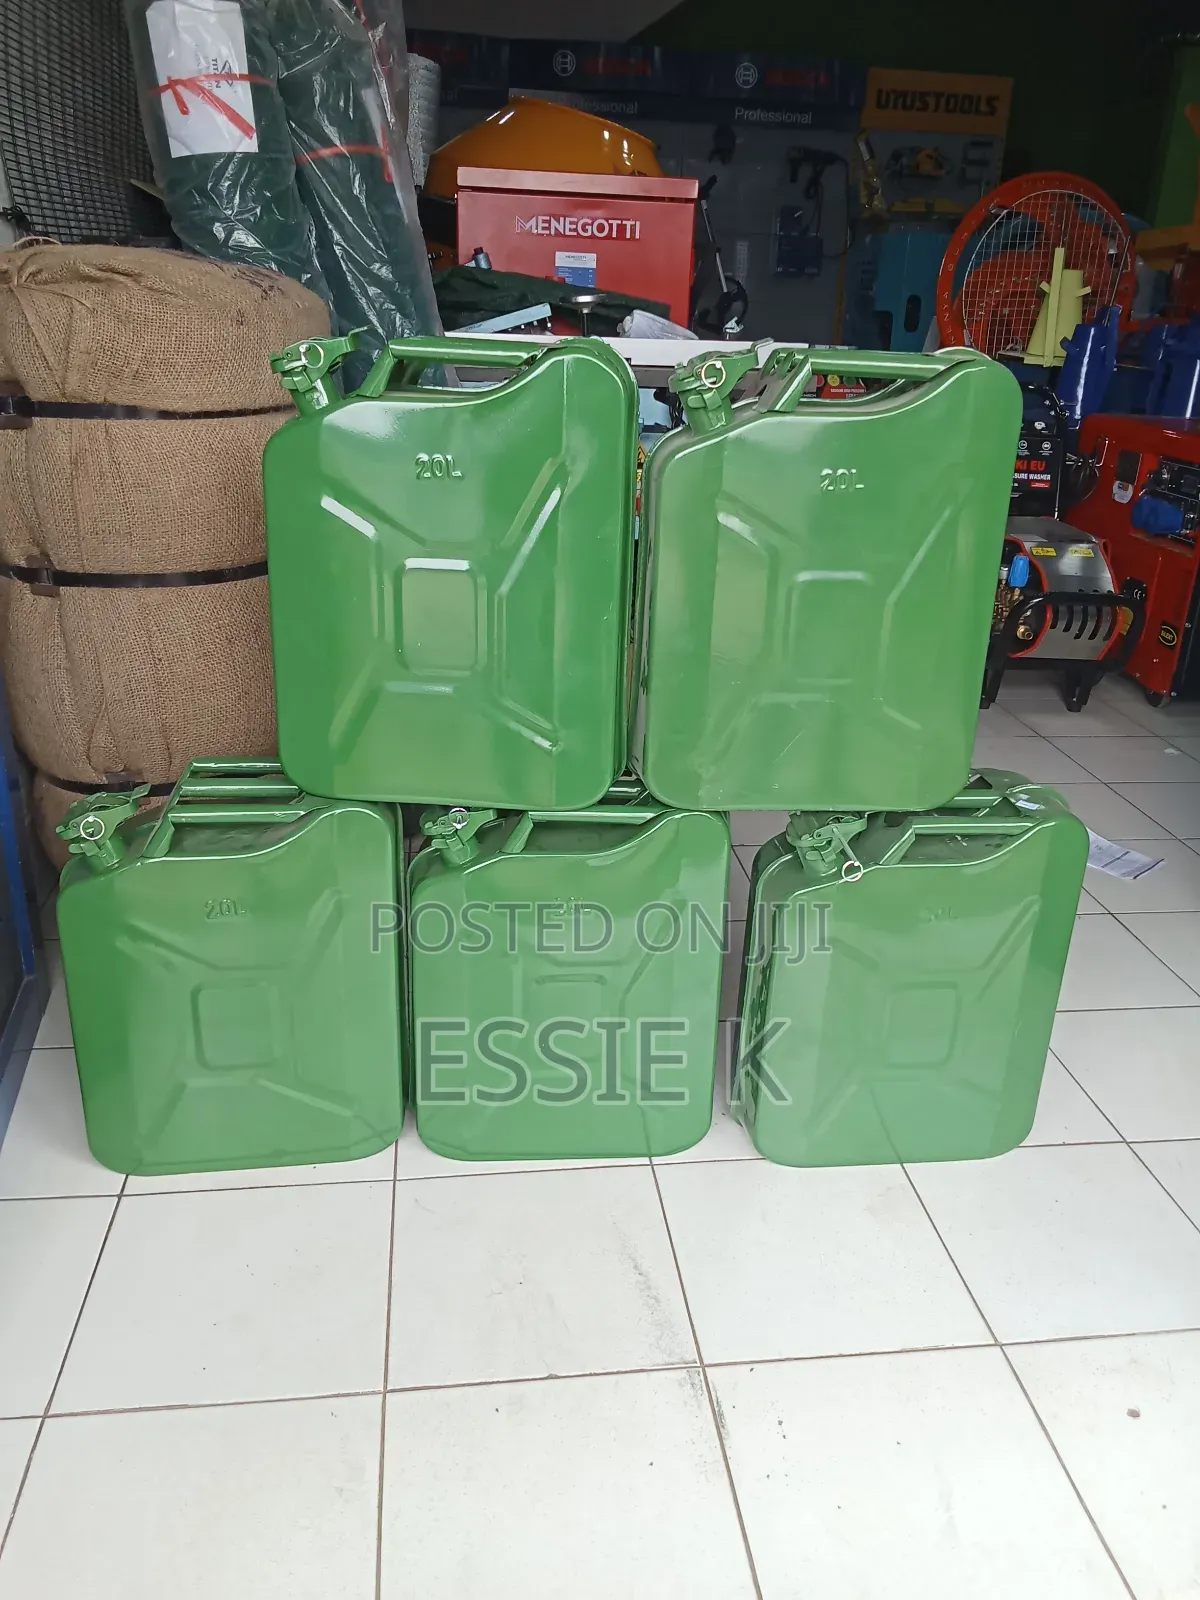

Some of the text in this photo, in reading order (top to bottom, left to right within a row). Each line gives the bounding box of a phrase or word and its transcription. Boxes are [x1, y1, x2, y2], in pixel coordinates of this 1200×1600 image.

[211, 57, 222, 89] TITN
[734, 106, 812, 124] Professional
[876, 88, 1000, 117] UYUSTOOLS
[514, 214, 641, 240] MENEGOTTI
[414, 452, 464, 480] 20L
[1012, 472, 1028, 480] SURE
[1030, 460, 1046, 472] EU
[820, 468, 865, 492] 20L
